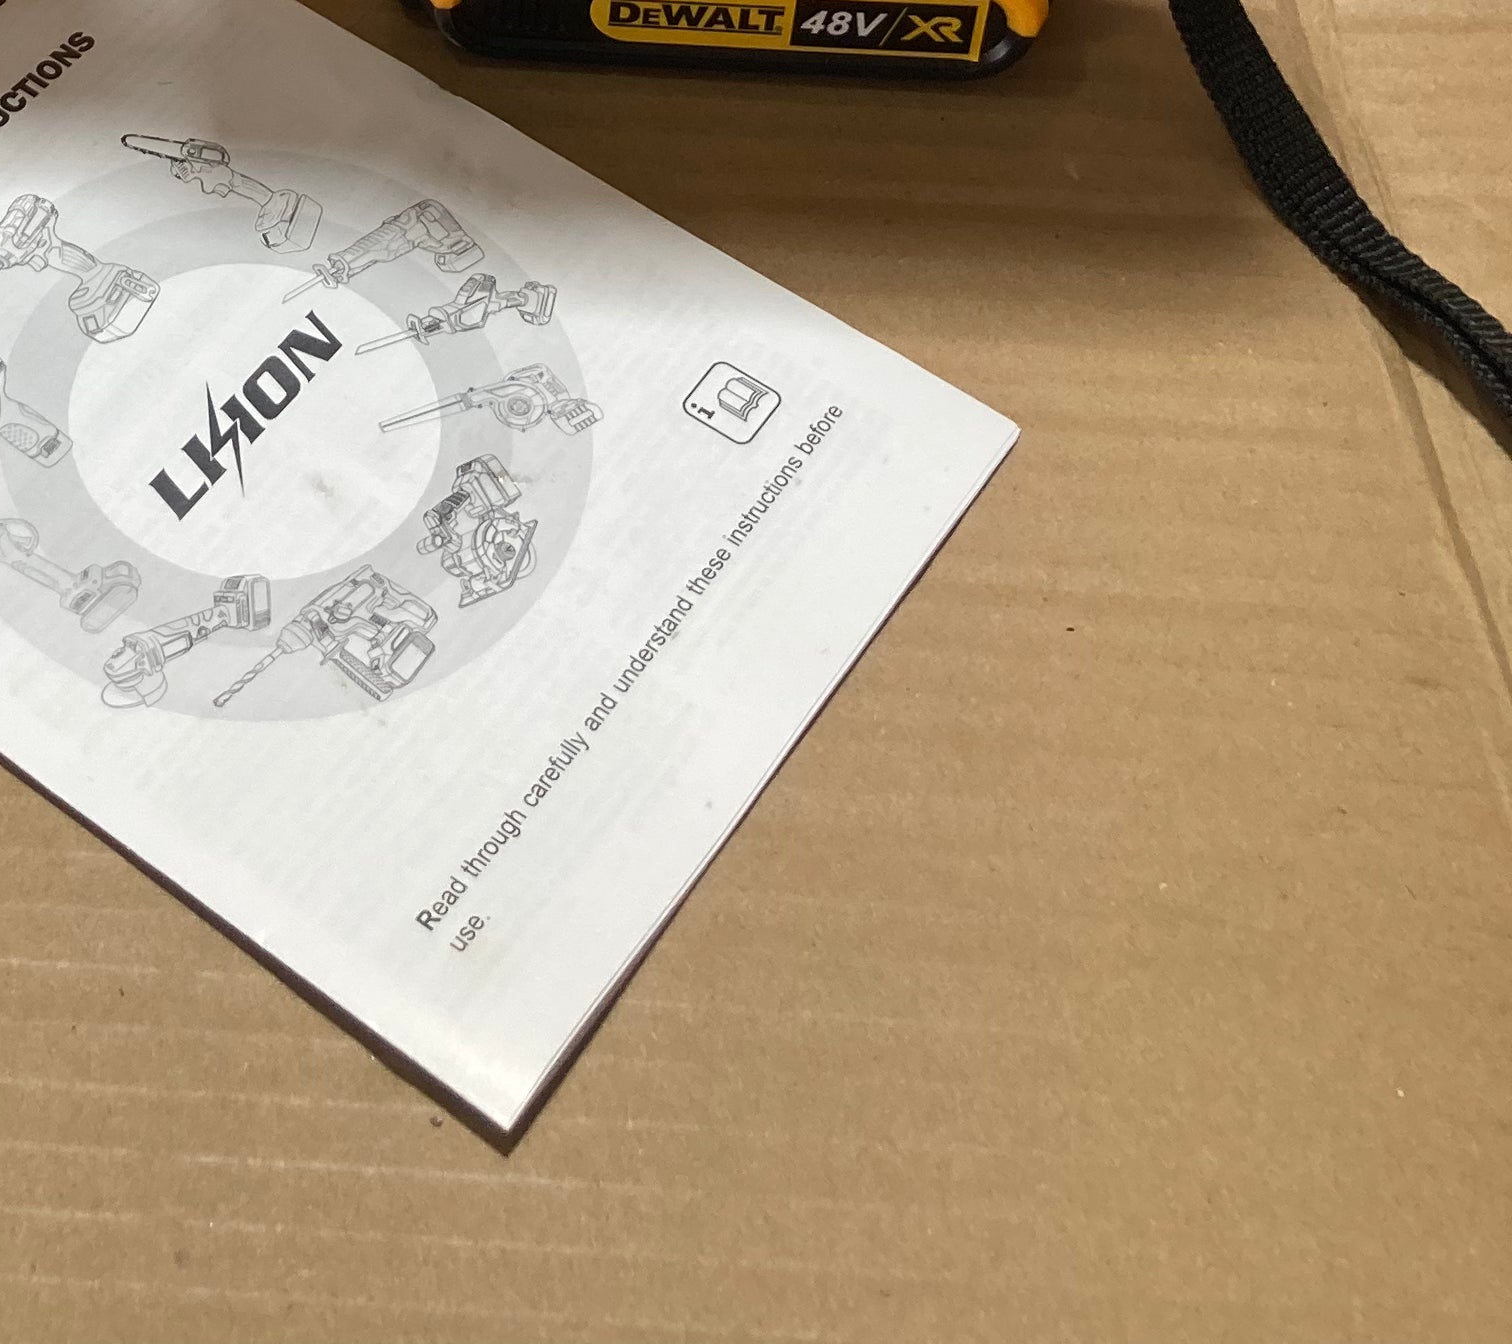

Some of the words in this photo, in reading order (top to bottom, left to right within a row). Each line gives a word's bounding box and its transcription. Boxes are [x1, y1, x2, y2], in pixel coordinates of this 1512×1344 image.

[415, 875, 469, 931] Read
[460, 809, 528, 878] through
[523, 731, 591, 808] carefully
[584, 692, 618, 732] and
[614, 595, 694, 694] understand
[687, 548, 732, 596] these
[728, 456, 804, 547] instructions
[793, 405, 844, 456] before
